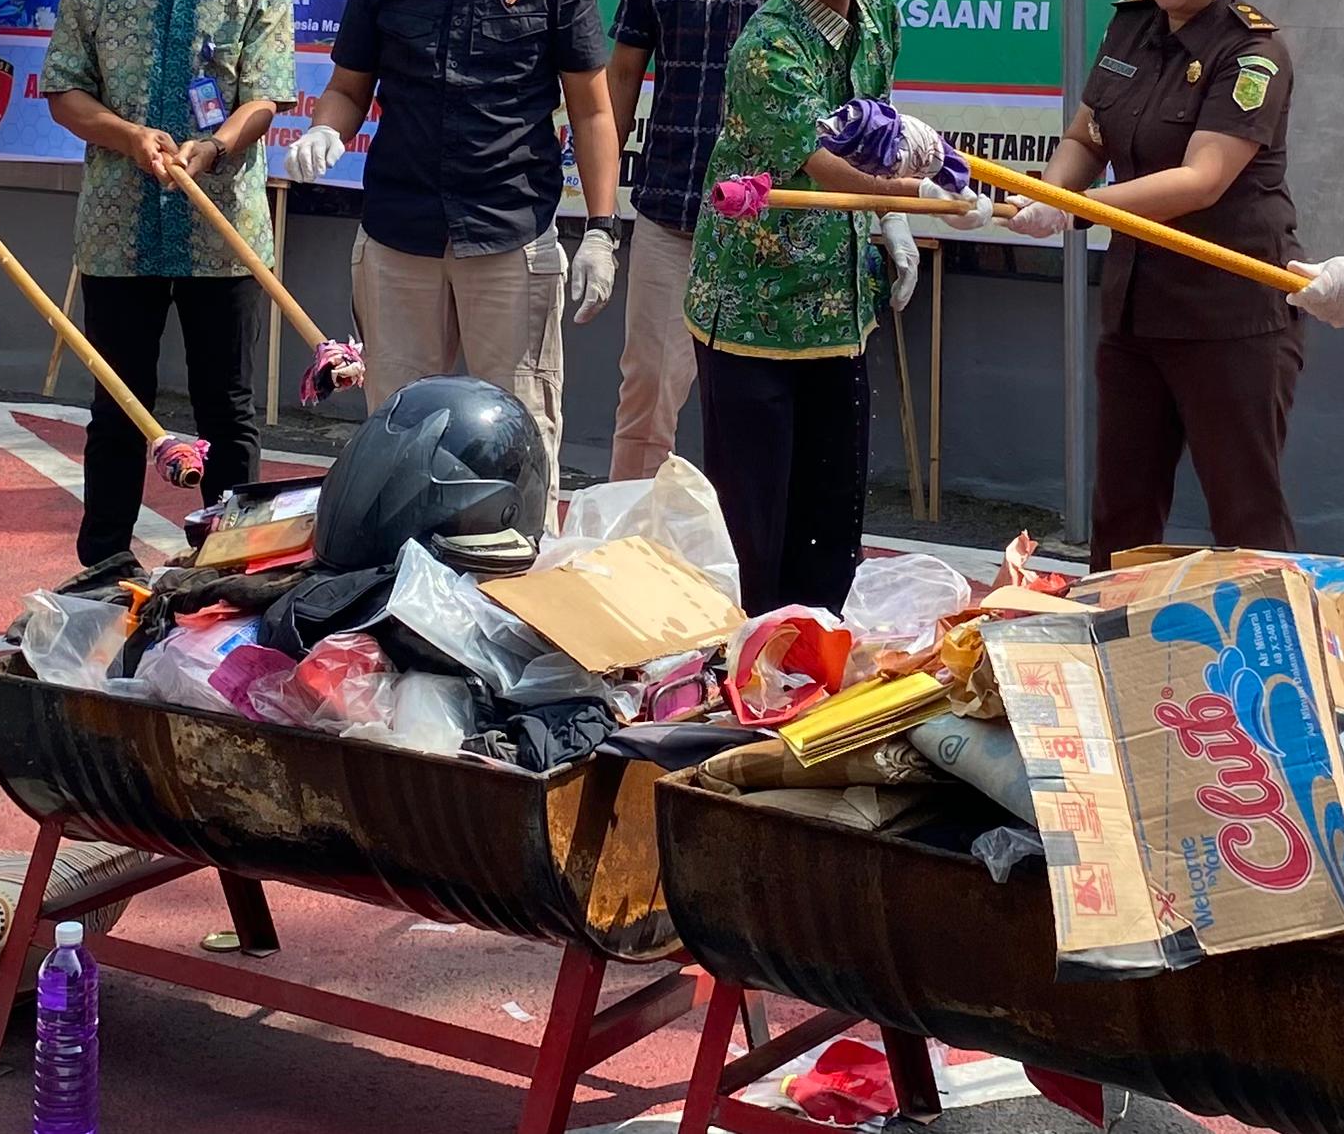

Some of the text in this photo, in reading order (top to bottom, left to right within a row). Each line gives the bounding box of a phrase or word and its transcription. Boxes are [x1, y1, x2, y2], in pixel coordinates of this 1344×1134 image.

[1012, 0, 1051, 31] RI
[1053, 737, 1077, 759] 8
[1154, 692, 1313, 893] Club
[1200, 832, 1220, 876] Your
[1180, 835, 1215, 932] Welcome
